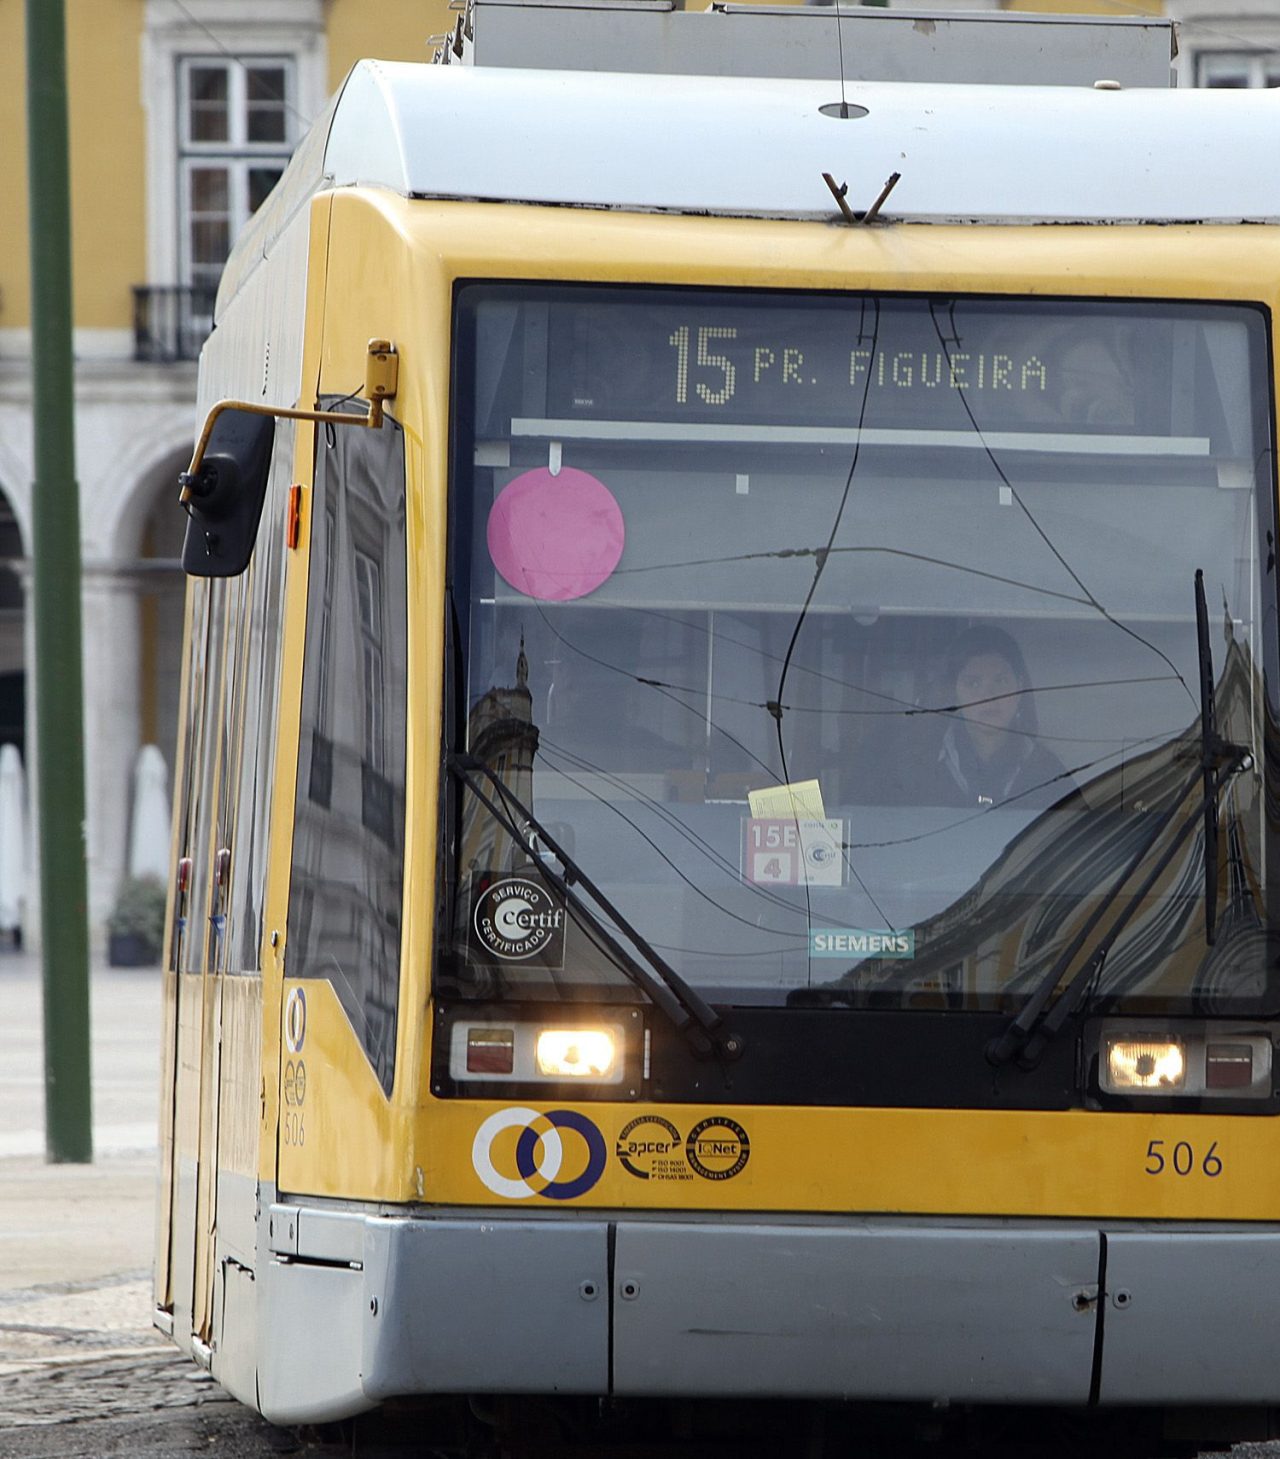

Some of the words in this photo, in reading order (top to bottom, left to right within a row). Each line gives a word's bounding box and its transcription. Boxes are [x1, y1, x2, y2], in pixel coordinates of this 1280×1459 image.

[669, 326, 736, 404] 15
[755, 347, 817, 384] PR.
[850, 351, 1046, 390] FIGUEIRA
[752, 825, 797, 849] 15E
[763, 858, 781, 878] 4
[492, 886, 539, 902] SERVIÇO
[482, 918, 545, 953] CERTIFICADO
[814, 933, 909, 953] SIEMENS
[285, 1112, 304, 1146] 506
[628, 1142, 671, 1157] apcer
[698, 1143, 737, 1155] IQNet
[1145, 1140, 1223, 1177] 506
